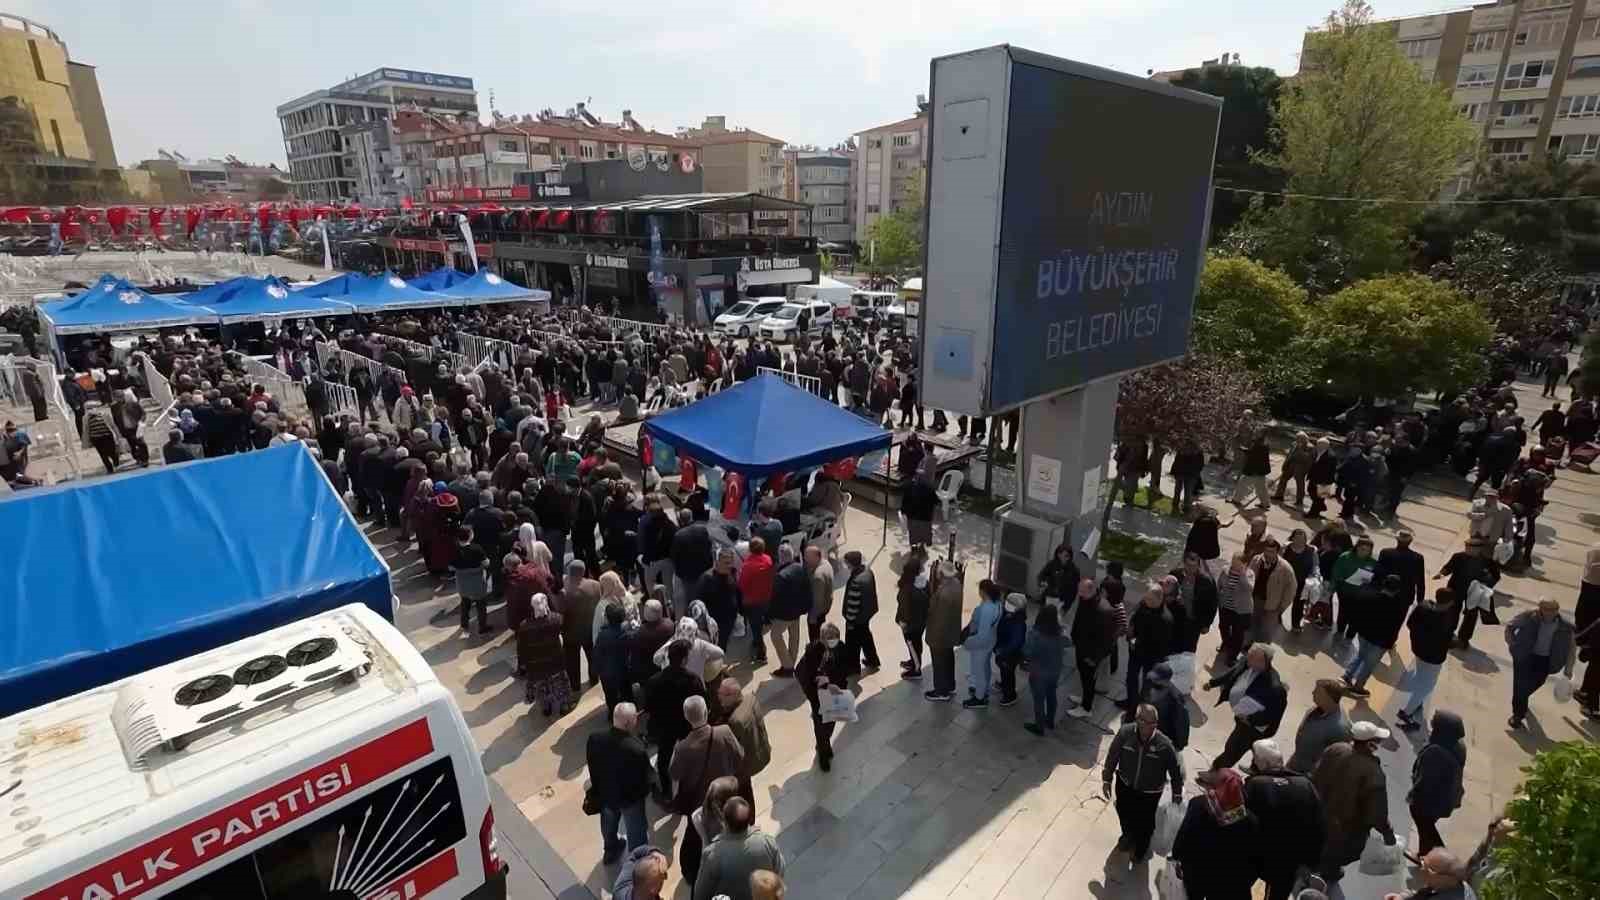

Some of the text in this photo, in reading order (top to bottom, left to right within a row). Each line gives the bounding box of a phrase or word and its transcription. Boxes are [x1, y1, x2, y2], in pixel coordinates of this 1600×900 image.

[1088, 192, 1153, 226] AYDIN
[1037, 242, 1178, 299] BÜYÜKŞEHİR
[61, 762, 353, 900] ALK PARTİSİ
